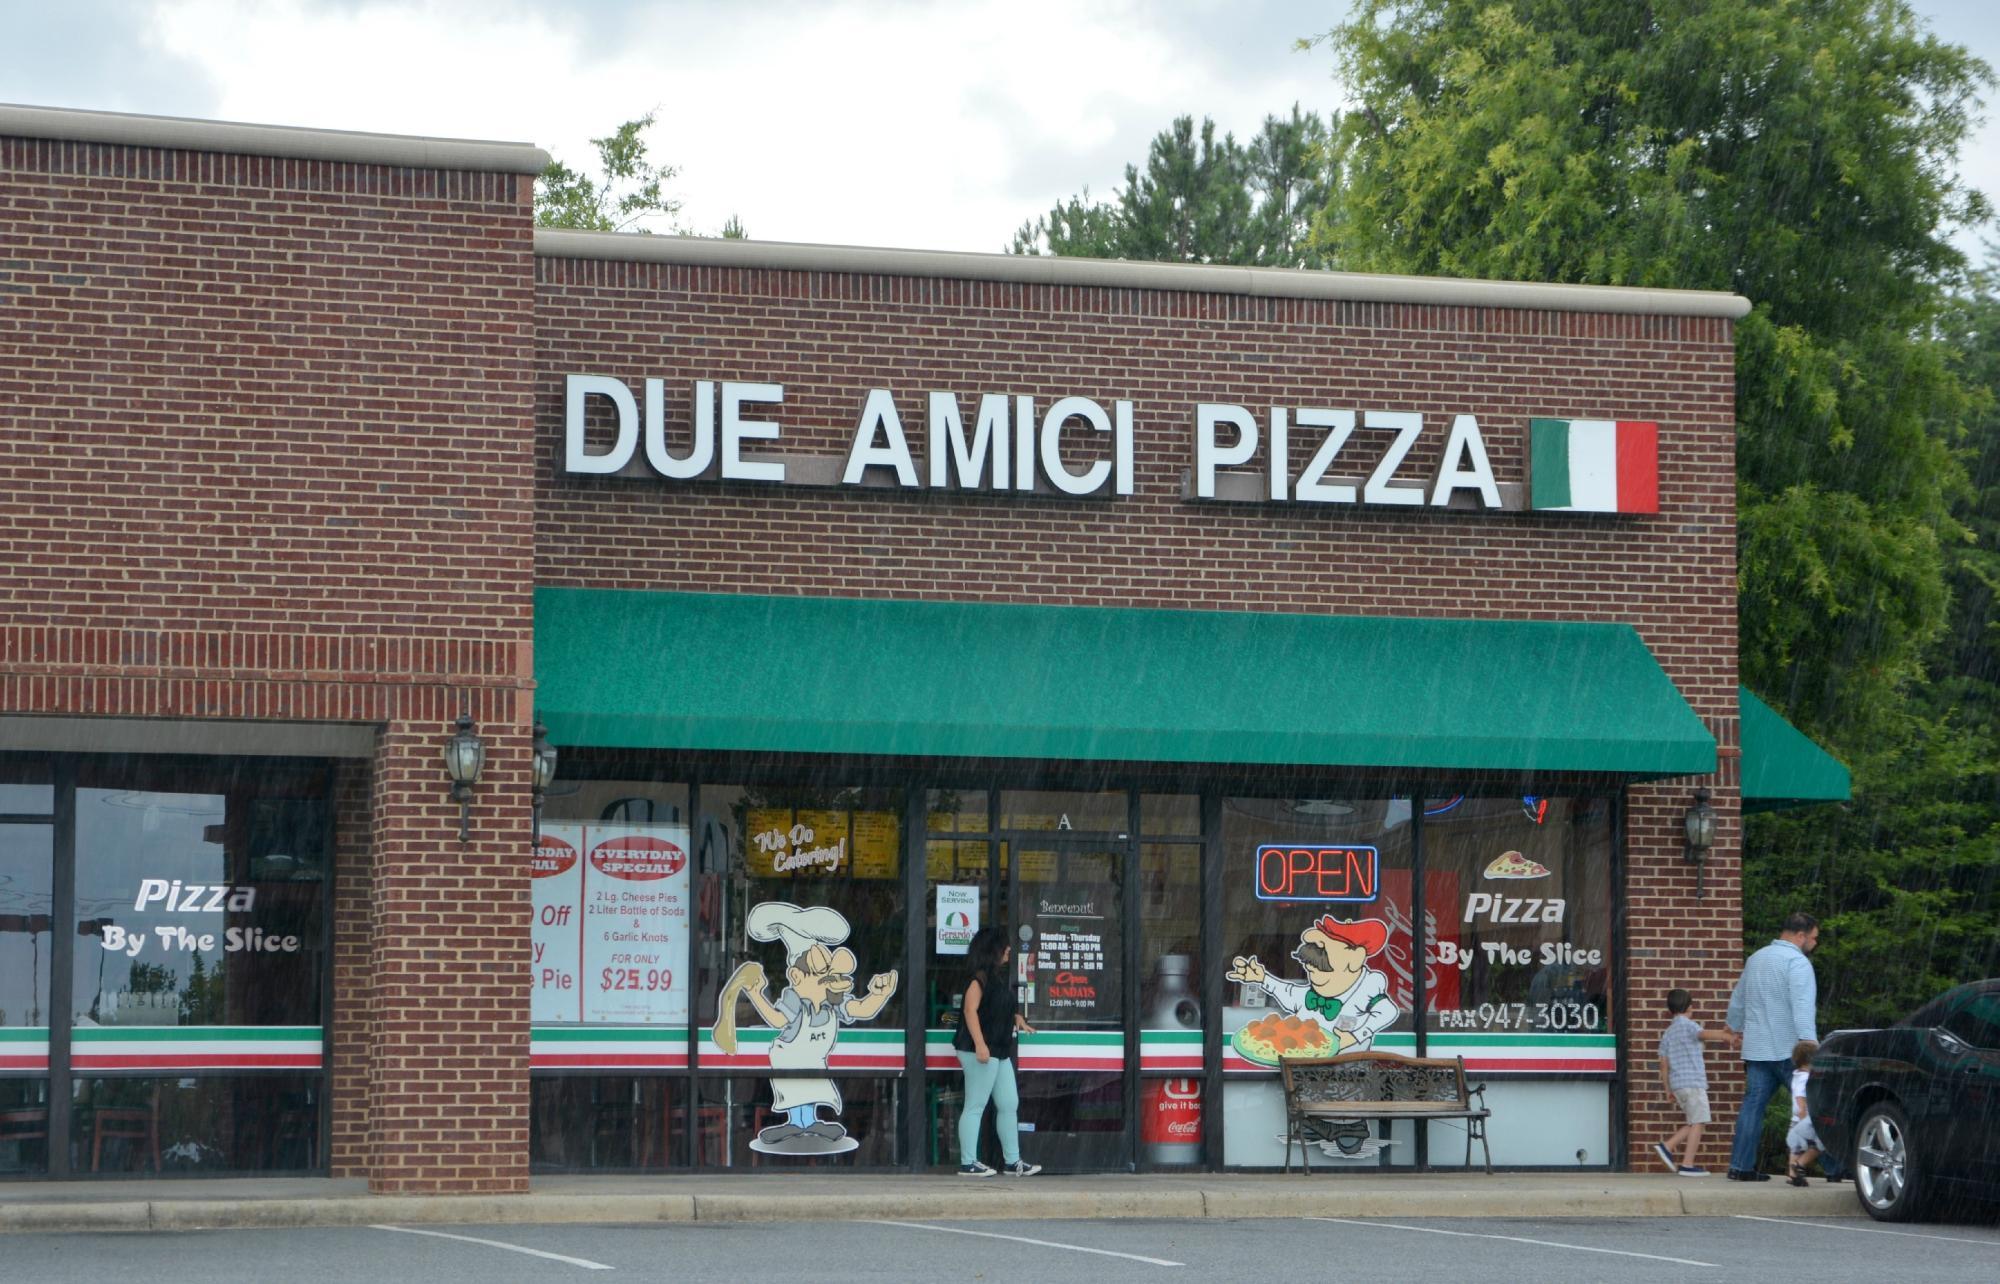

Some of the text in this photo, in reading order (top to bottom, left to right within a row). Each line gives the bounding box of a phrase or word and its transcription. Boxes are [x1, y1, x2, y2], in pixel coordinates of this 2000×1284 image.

[566, 374, 1503, 508] DUE AMICI PIZZA
[1058, 813, 1073, 830] A
[753, 828, 788, 853] We
[788, 824, 814, 846] Do
[594, 849, 682, 861] EVERYDAY
[774, 837, 846, 872] Catering!
[602, 862, 674, 874] SPECIAL
[1260, 849, 1372, 896] OPEN
[133, 879, 257, 912] Pizza
[596, 892, 678, 903] 2 Lg. Cheese Pies
[541, 905, 572, 926] Off
[589, 905, 686, 916] 2 Liter Bottle of Soda
[1464, 893, 1566, 923] Pizza
[633, 919, 640, 928] &
[101, 925, 299, 957] By The Slice
[604, 932, 669, 943] 6 Garlic Knots
[1040, 933, 1066, 942] Monday
[1070, 933, 1100, 943] Thursday
[1058, 942, 1069, 951] AM
[1090, 943, 1101, 952] PM
[1436, 941, 1602, 971] By The Slice
[611, 954, 660, 964] FOR ONLY
[542, 969, 572, 989] Pie
[600, 967, 673, 992] $25.99
[1049, 987, 1096, 998] SUNDAYS
[1439, 1002, 1600, 1030] FAX 947-3030
[1159, 1101, 1178, 1111] give
[1180, 1101, 1187, 1110] it
